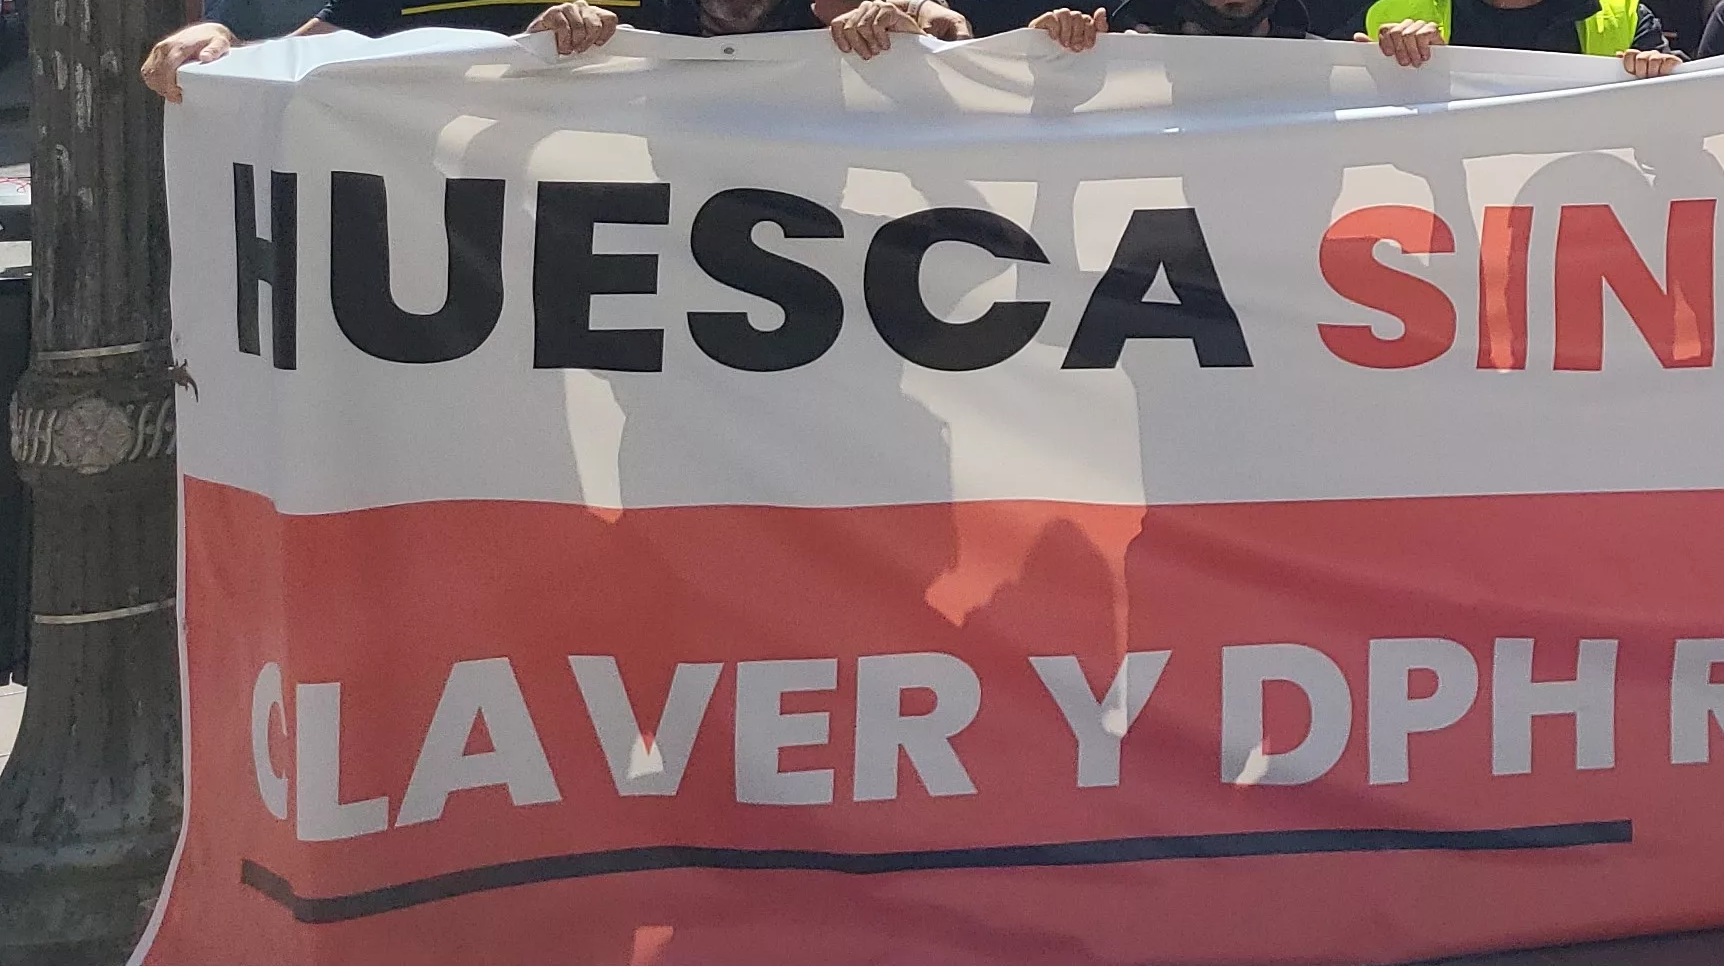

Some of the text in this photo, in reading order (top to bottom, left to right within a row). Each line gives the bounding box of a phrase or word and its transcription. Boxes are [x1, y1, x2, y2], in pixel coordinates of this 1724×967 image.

[232, 161, 1254, 372] HUESCA
[1316, 198, 1718, 371] SIN
[251, 651, 982, 842] CLAVER
[1028, 649, 1172, 789] Y
[1220, 637, 1619, 786] DPH
